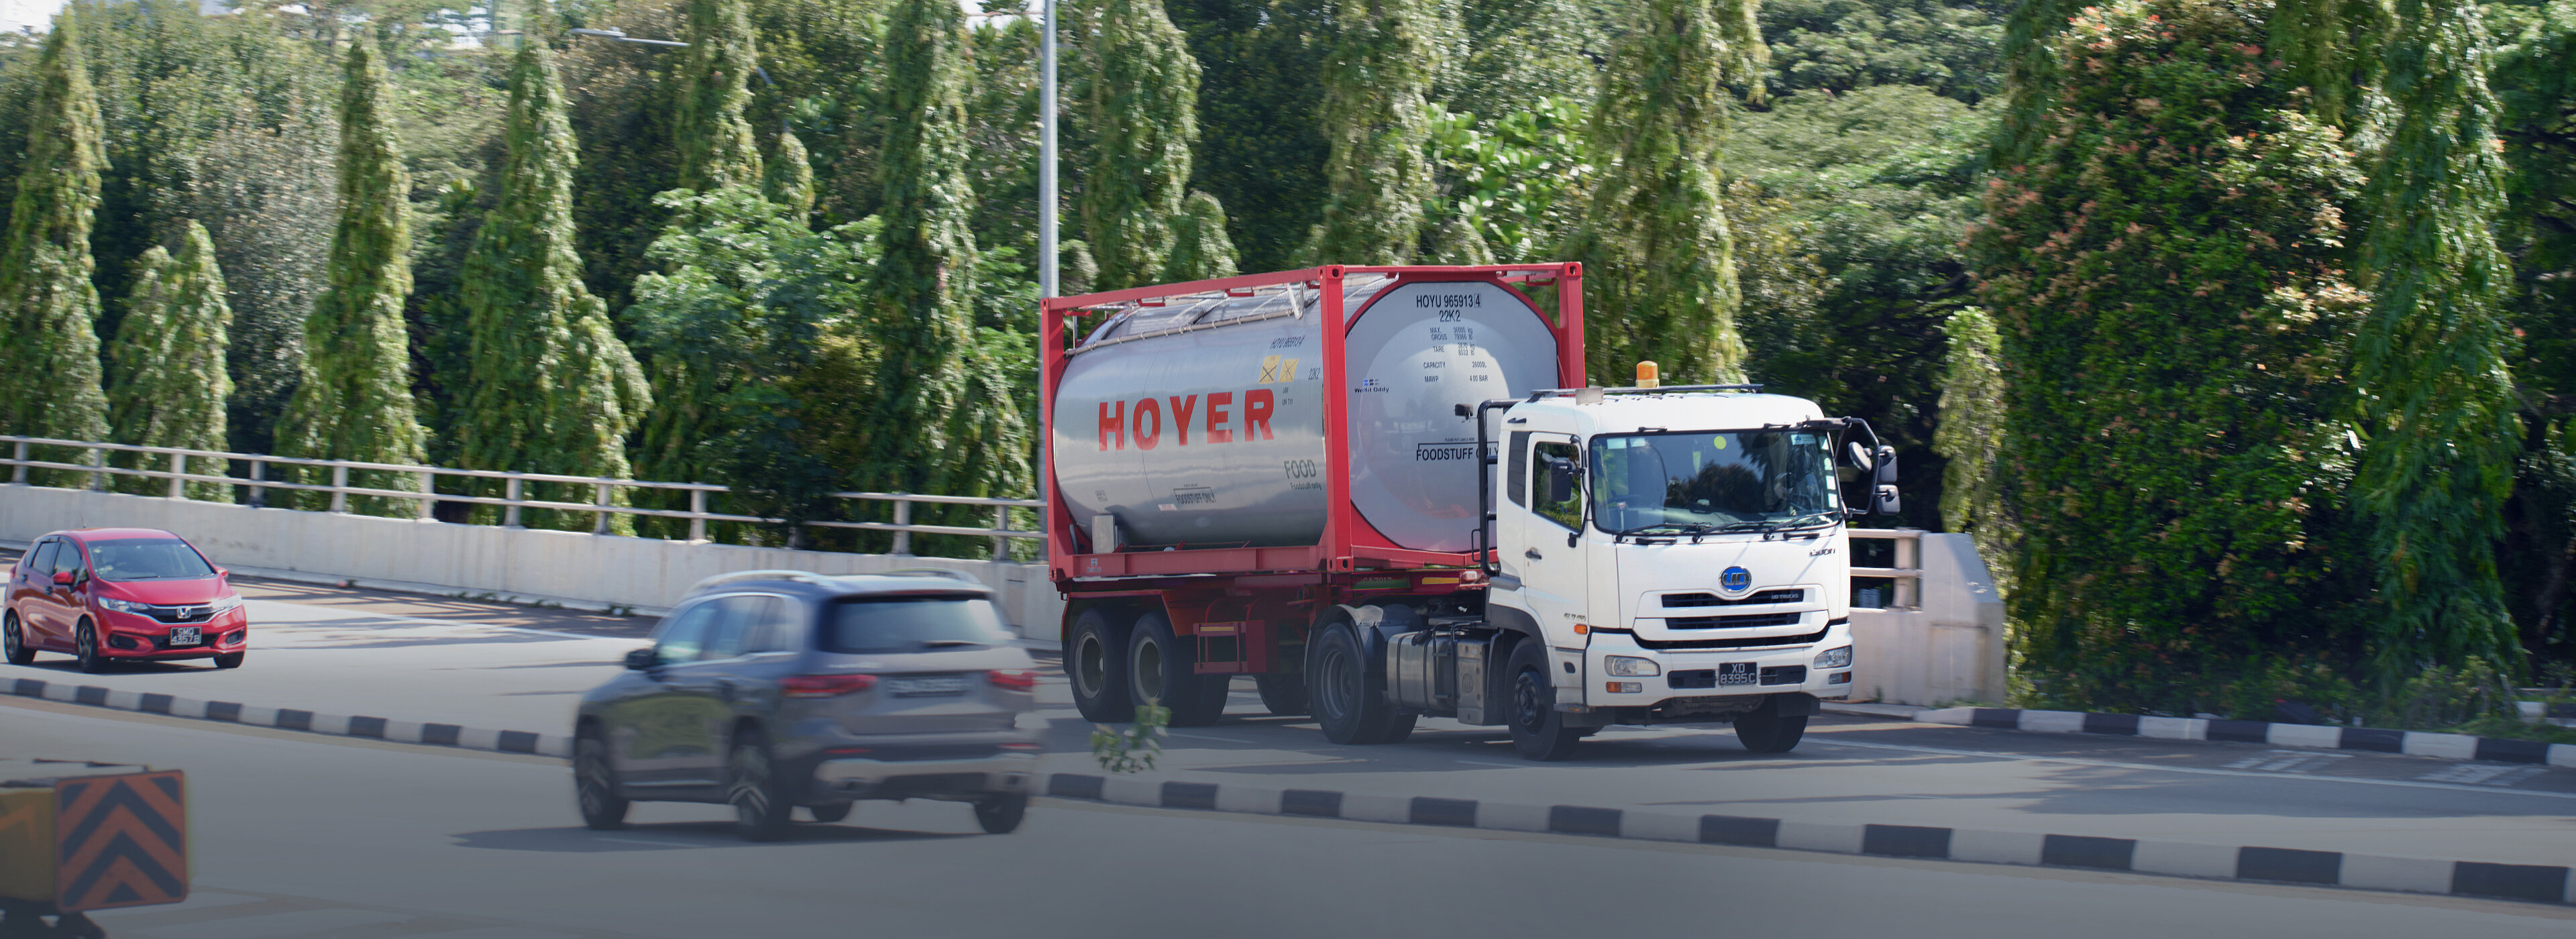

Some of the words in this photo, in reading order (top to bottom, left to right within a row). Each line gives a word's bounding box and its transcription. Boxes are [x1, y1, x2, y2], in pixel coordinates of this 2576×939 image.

[1416, 294, 1442, 308] HOYU
[1444, 294, 1473, 308] 965913
[1439, 309, 1461, 322] 22K2
[1467, 327, 1473, 335] kg
[1308, 368, 1321, 380] 22K2
[1098, 388, 1275, 451] HOYER
[1416, 447, 1473, 461] FOODSTUFF
[1284, 459, 1316, 479] FOOD
[1175, 493, 1201, 504] FOODSTUFF
[1201, 492, 1216, 504] ONLY
[1722, 572, 1750, 586] UD
[1731, 663, 1746, 673] XD
[1720, 673, 1756, 684] 8395C
